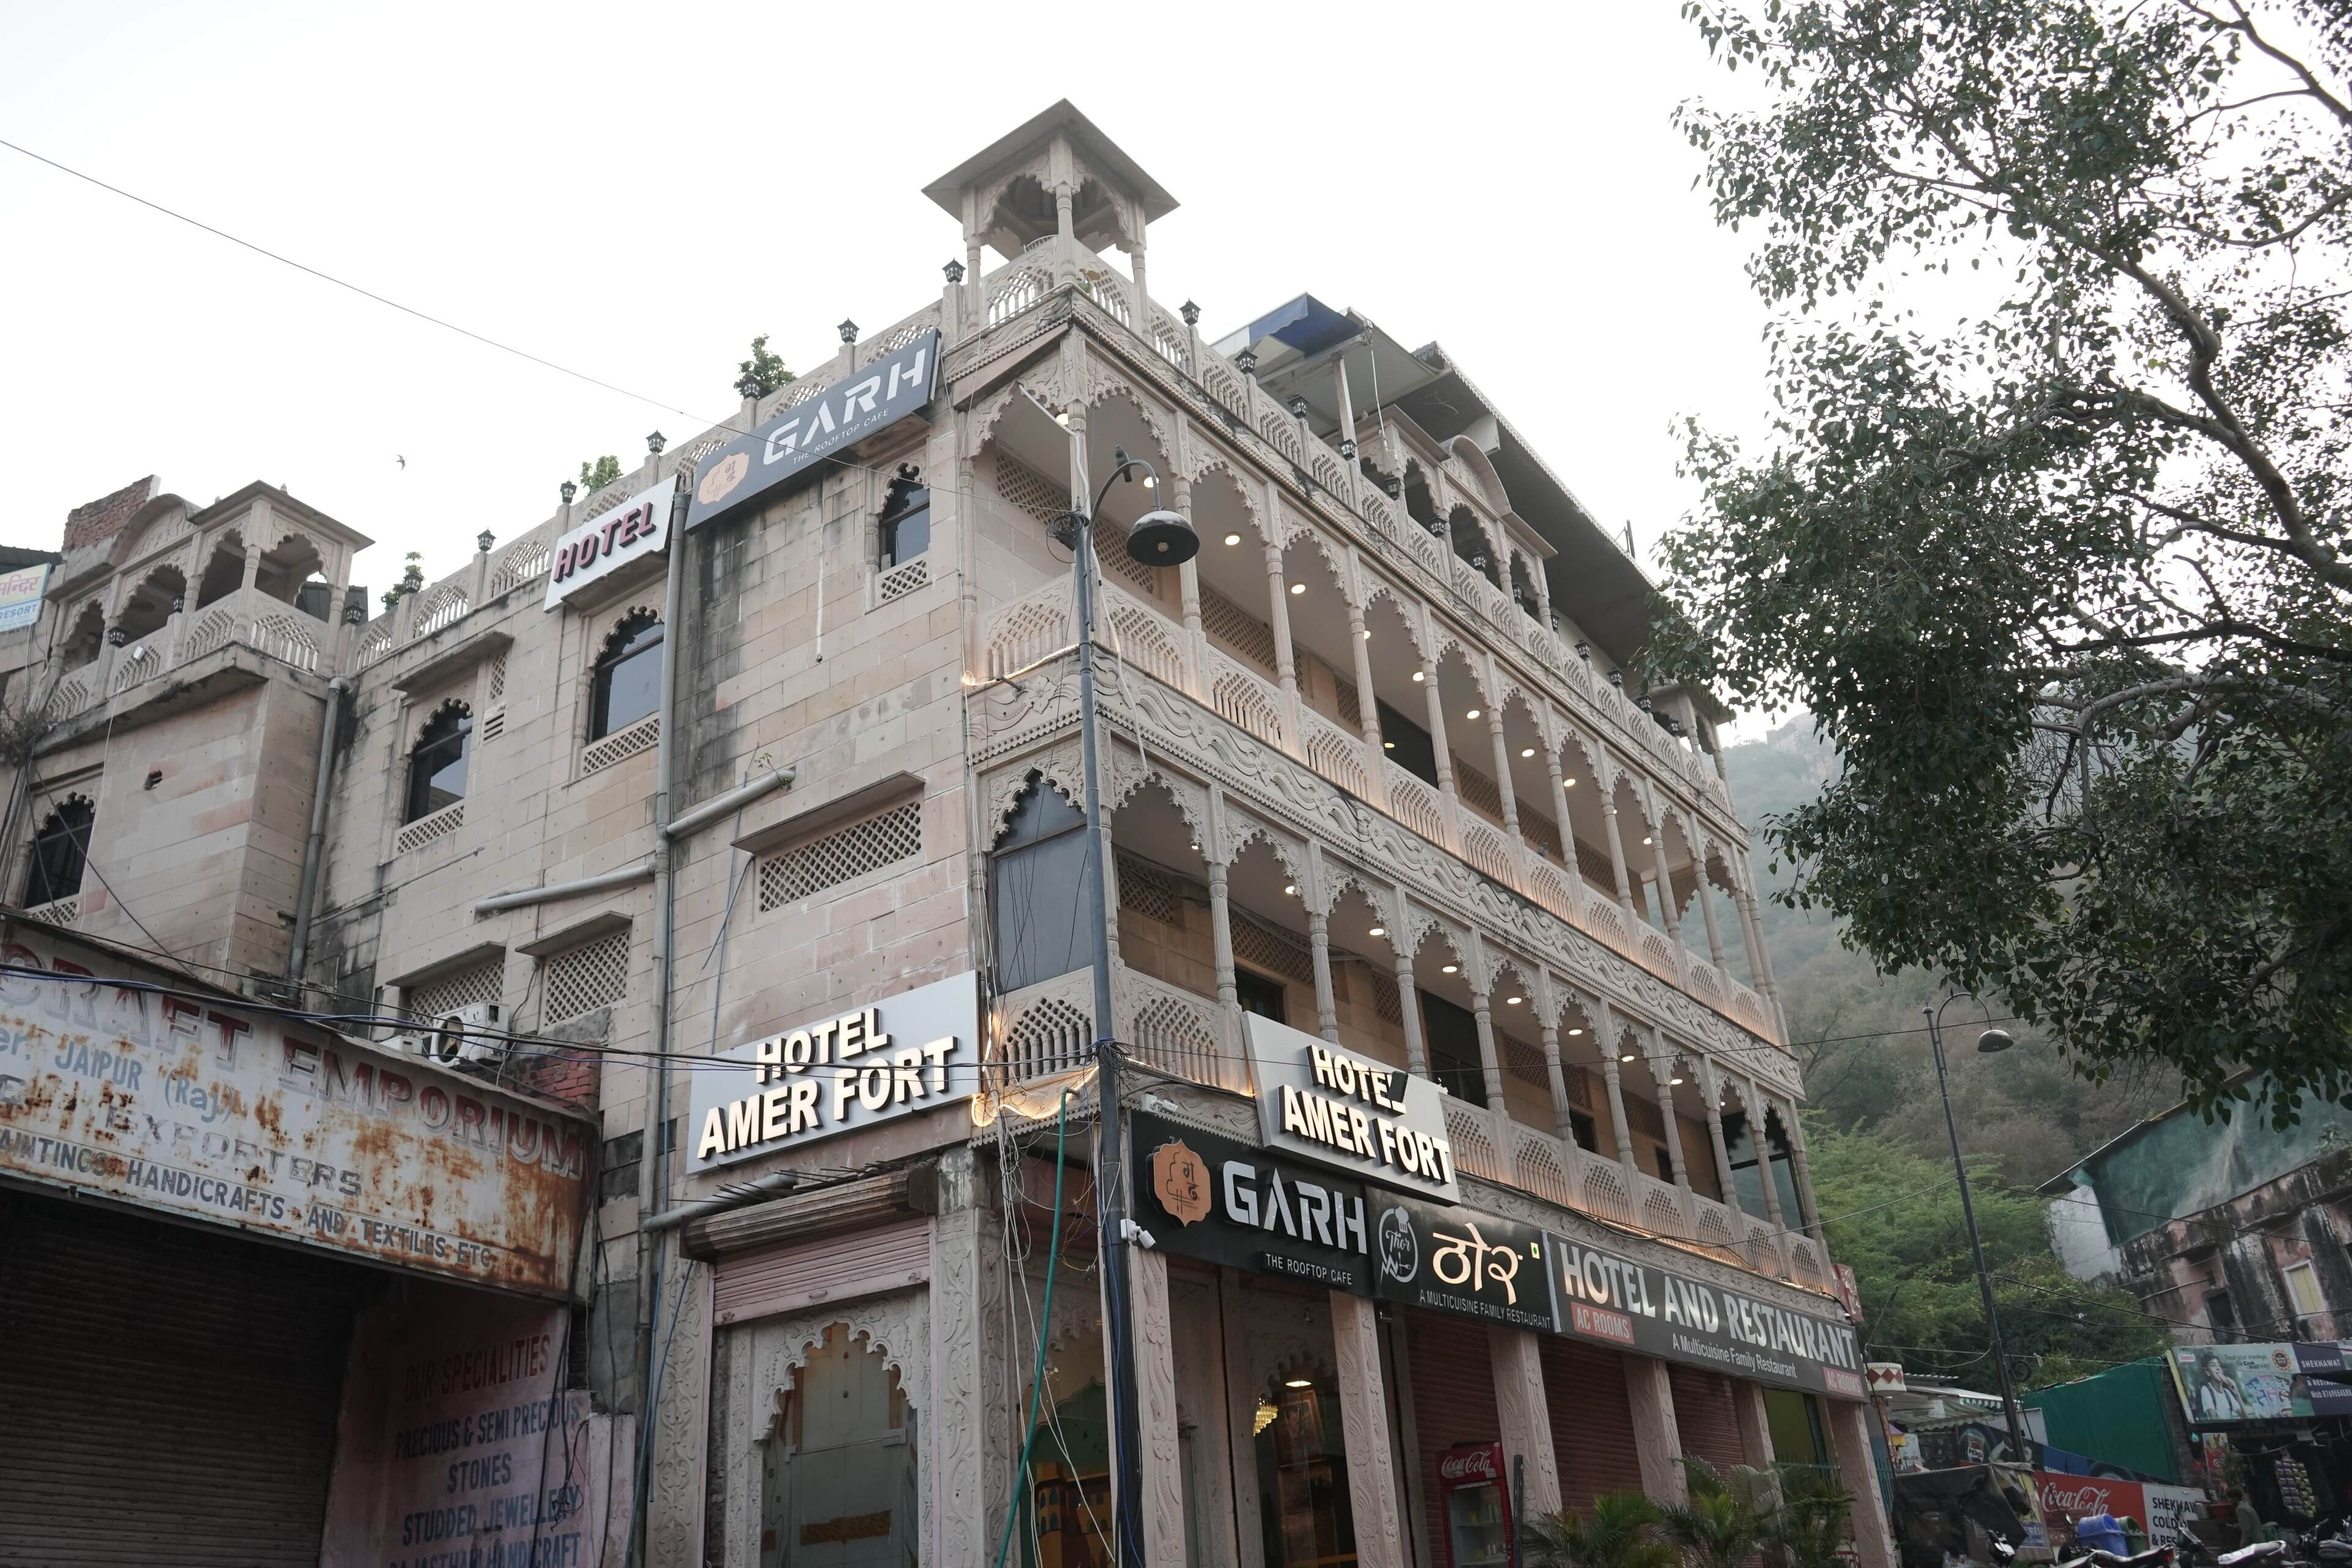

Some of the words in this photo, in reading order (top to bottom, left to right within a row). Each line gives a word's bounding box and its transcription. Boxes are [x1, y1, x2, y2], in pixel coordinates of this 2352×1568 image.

[763, 347, 925, 466] GARH
[793, 450, 810, 464] THE
[815, 424, 859, 453] ROOFTOP
[864, 408, 889, 426] CAFE
[554, 502, 656, 583] HOTEL
[0, 604, 37, 619] RESORT
[756, 1008, 891, 1085] HOTEL
[55, 1041, 143, 1091] JAIPUR
[165, 1068, 234, 1124] (Raj)
[697, 1079, 823, 1159] AMER
[834, 1036, 958, 1121] FORT
[278, 1035, 582, 1180] EMPORIUM
[105, 1105, 362, 1197] EXPORTERS
[1280, 1084, 1376, 1159] AMER
[1373, 1117, 1452, 1185] FORT
[127, 1160, 285, 1219] HANDICRAFTS
[306, 1206, 344, 1235] AND
[361, 1218, 445, 1257] TEXTILES
[1223, 1160, 1367, 1255] GARH
[1385, 1229, 1411, 1253] Thor
[1265, 1253, 1283, 1269] THE
[1287, 1259, 1327, 1280] ROOFTOP
[1330, 1271, 1352, 1286] CAFE
[1420, 1289, 1425, 1302] A
[1427, 1294, 1479, 1314] MULTICUISINE
[1480, 1302, 1506, 1319] FAMILY
[1507, 1310, 1551, 1329] RESTAURANT
[1560, 1242, 1656, 1318] HOTEL
[1664, 1275, 1719, 1334] AND
[1724, 1292, 1856, 1370] RESTAURANT
[1577, 1308, 1591, 1330] AC
[1593, 1311, 1629, 1340] ROOMS
[405, 1363, 435, 1403] OUR
[441, 1334, 550, 1395] SPECIALITIES
[1673, 1333, 1680, 1351] A
[1680, 1335, 1730, 1362] Multicuisine
[1730, 1348, 1755, 1372] Family
[1756, 1354, 1797, 1378] Restaurant
[2301, 1359, 2341, 1368] SHEKHAWAT
[1827, 1371, 1837, 1388] AC
[1837, 1373, 1861, 1393] ROOMS
[396, 1418, 460, 1461] PRECIOUS
[464, 1417, 473, 1446] &
[477, 1412, 509, 1445] SEMI
[513, 1396, 579, 1437] PRECIOUS
[448, 1453, 511, 1493] STONES
[1441, 1450, 1492, 1479] Coca-Cola
[2041, 1482, 2111, 1517] Coca-Cola
[2152, 1497, 2195, 1513] SHEKHAW
[2153, 1515, 2177, 1529] COLD
[402, 1504, 477, 1546] STUDDED
[2152, 1534, 2158, 1546] &
